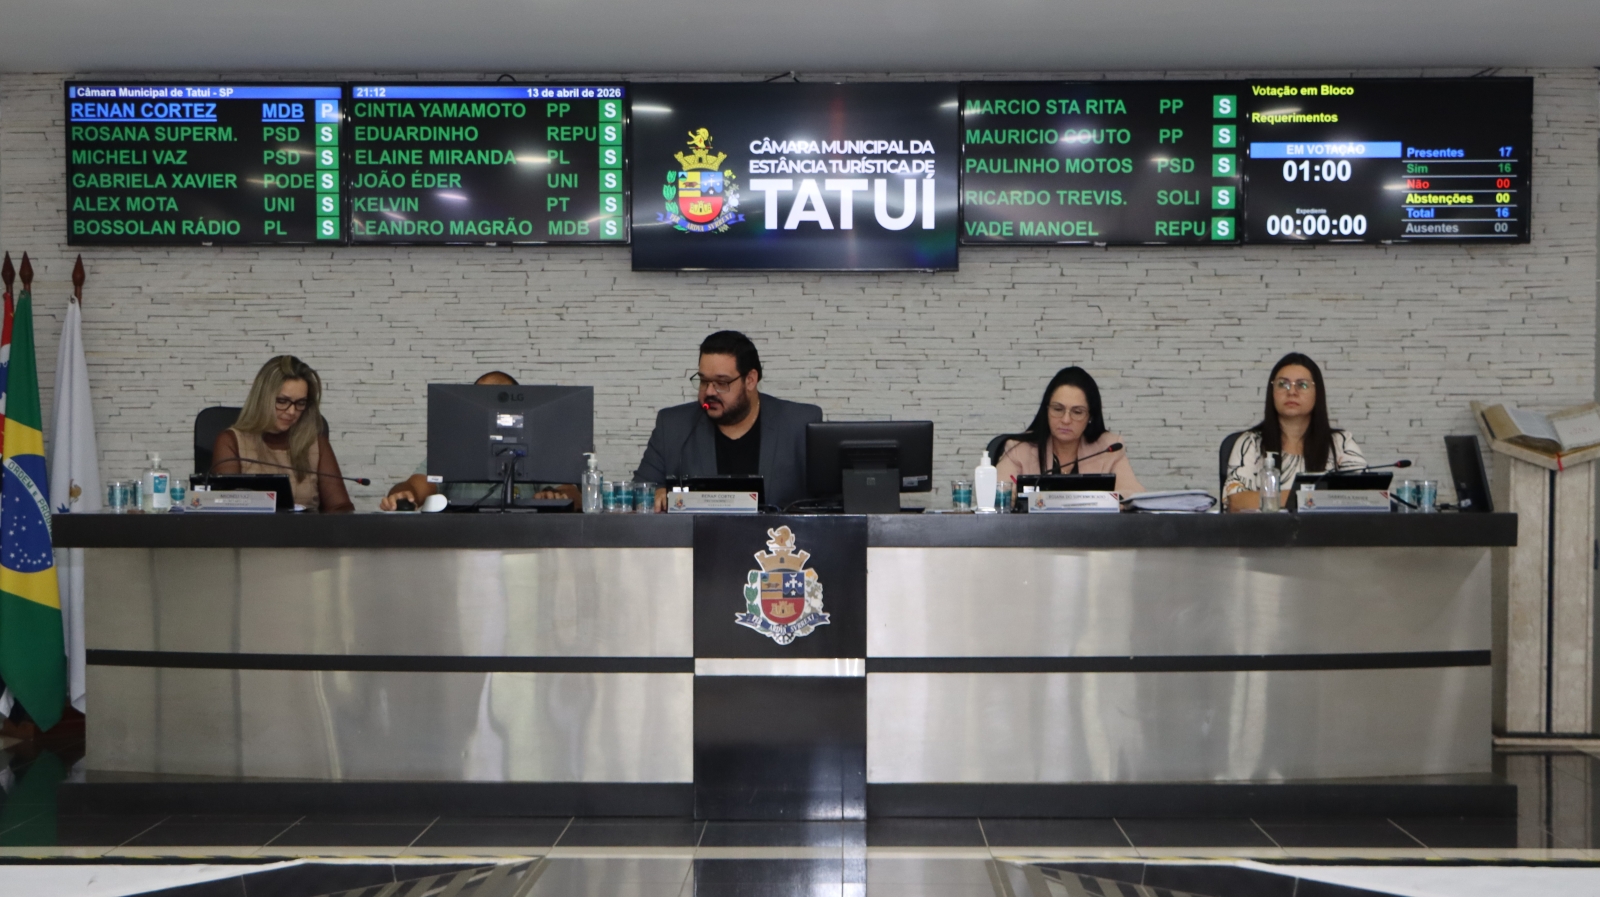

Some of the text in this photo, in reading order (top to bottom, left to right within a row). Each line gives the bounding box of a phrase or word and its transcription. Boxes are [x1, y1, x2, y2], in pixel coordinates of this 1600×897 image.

[77, 87, 116, 97] Câmara
[119, 88, 168, 99] Municipal
[170, 88, 183, 97] de
[219, 88, 233, 97] SP
[356, 88, 385, 97] 21:12
[527, 88, 621, 98] 13 de abril de 2026
[1252, 85, 1354, 98] Votação em Bloco
[71, 103, 333, 118] RENAN CORTEZ MDB P
[355, 103, 616, 118] CINTIA YAMAMOTO PP S
[965, 99, 1231, 115] MARCIO STA RITA PP S
[1252, 113, 1338, 124] Requerimentos
[72, 127, 333, 142] ROSANA SUPERM. PSD S
[355, 127, 616, 141] EDUARDINHO REPU S
[966, 129, 1231, 144] MAURICIO COUTO PP S
[750, 137, 934, 155] CÂMARA MUNICIPAL DA
[1286, 143, 1365, 156] EM VOTAÇÃO
[1407, 148, 1512, 158] Presentes 17
[72, 150, 333, 165] MICHELI VAZ PSD S
[355, 150, 616, 165] ELAINE MIRANDA PL S
[750, 156, 935, 174] ESTÂNCIA TURÍSTICA DE
[965, 158, 1230, 173] PAULINHO MOTOS PSD S
[1283, 160, 1352, 182] 01:00
[1406, 164, 1511, 173] Sim 16
[72, 173, 333, 189] GABRIELA XAVIER PODE S
[355, 170, 617, 188] JOÃO ÉDER UNI S
[1406, 179, 1510, 189] Não 00
[72, 197, 334, 212] ALEX MOTA UNI S
[355, 197, 617, 212] KELVIN PT S
[750, 172, 935, 231] TATUÍ
[965, 190, 1230, 205] RICARDO TREVIS. SOLI S
[1405, 193, 1510, 205] Abstenções 00
[1406, 209, 1509, 218] Total 16
[74, 217, 334, 235] BOSSOLAN RÁDIO PL S
[355, 218, 617, 235] LEANDRO MAGRÃO MDB S
[965, 221, 1229, 236] VADE MANOEL REPU S
[1266, 215, 1367, 236] 00:00:00
[1405, 223, 1508, 233] Ausentes 00
[511, 393, 524, 401] LG
[8, 462, 34, 489] ORDEM
